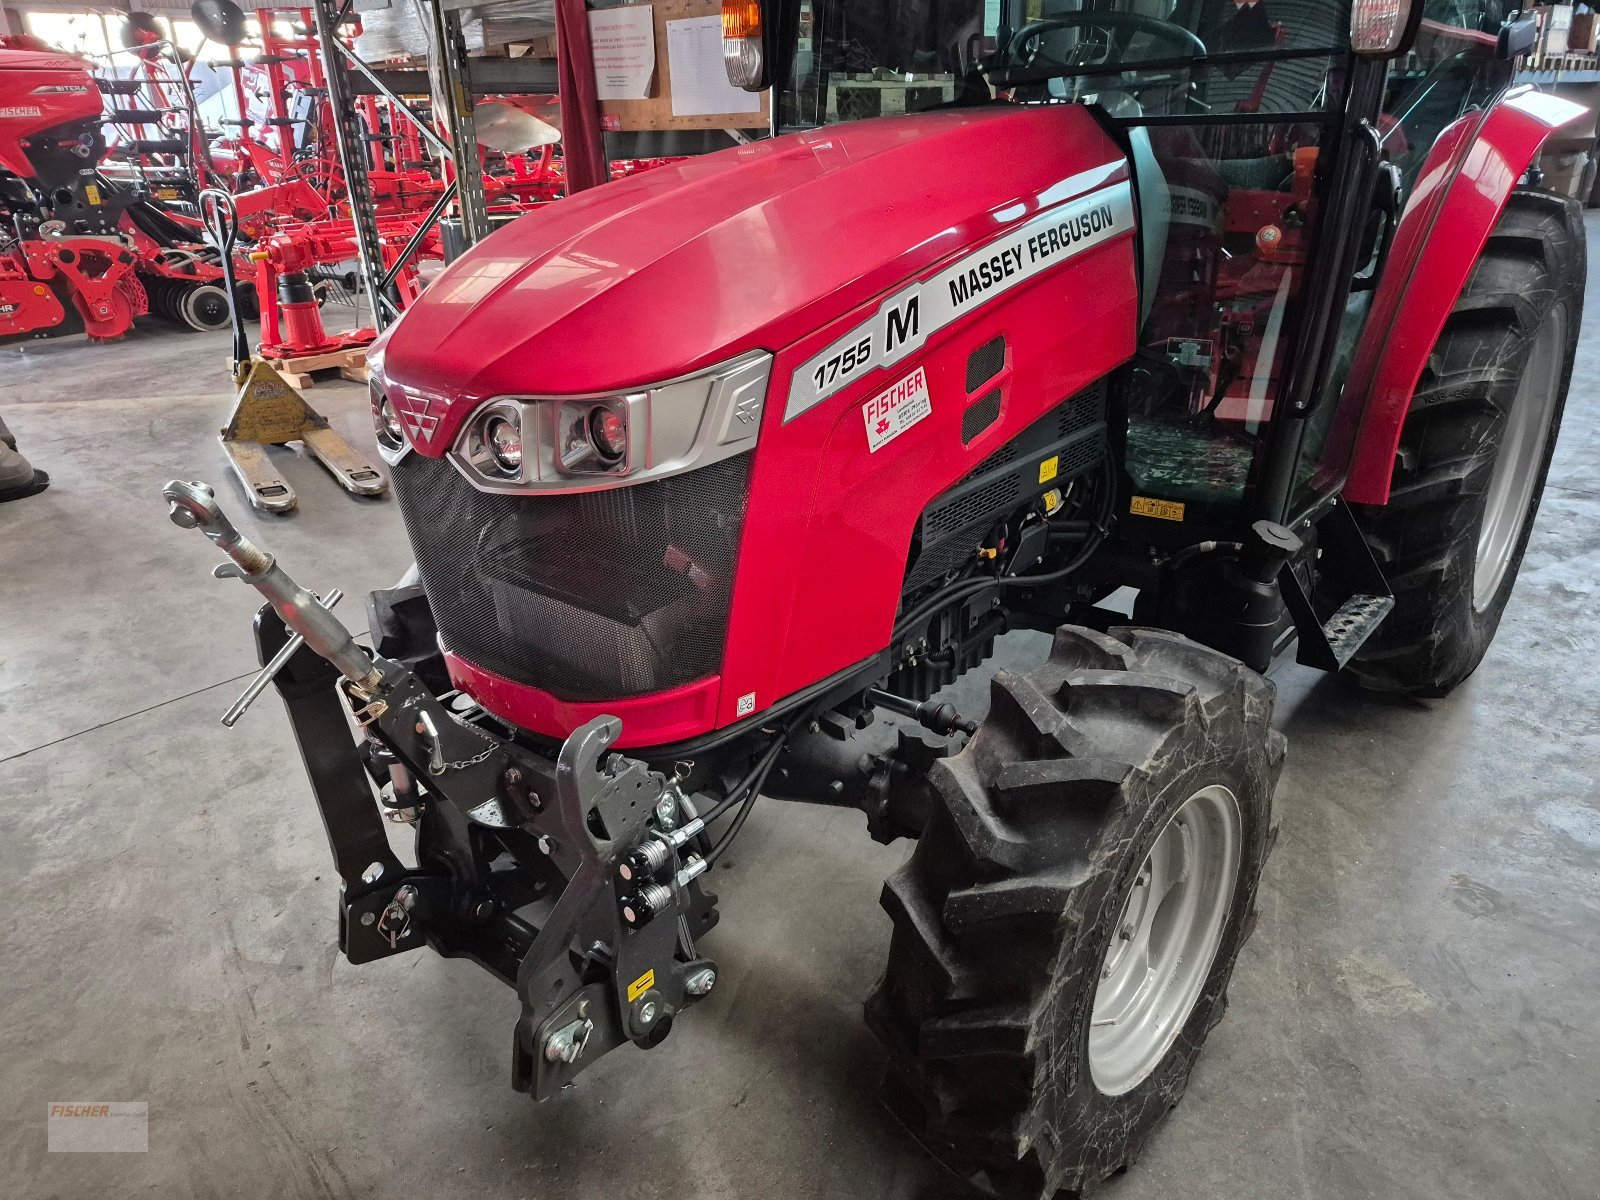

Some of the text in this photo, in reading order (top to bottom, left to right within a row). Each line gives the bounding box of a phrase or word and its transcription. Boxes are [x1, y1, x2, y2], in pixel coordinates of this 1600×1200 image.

[814, 337, 871, 391] 1755
[885, 295, 919, 353] M
[948, 243, 1022, 307] MASSEY
[1027, 205, 1114, 263] FERGUSON
[867, 371, 923, 424] FISCHER
